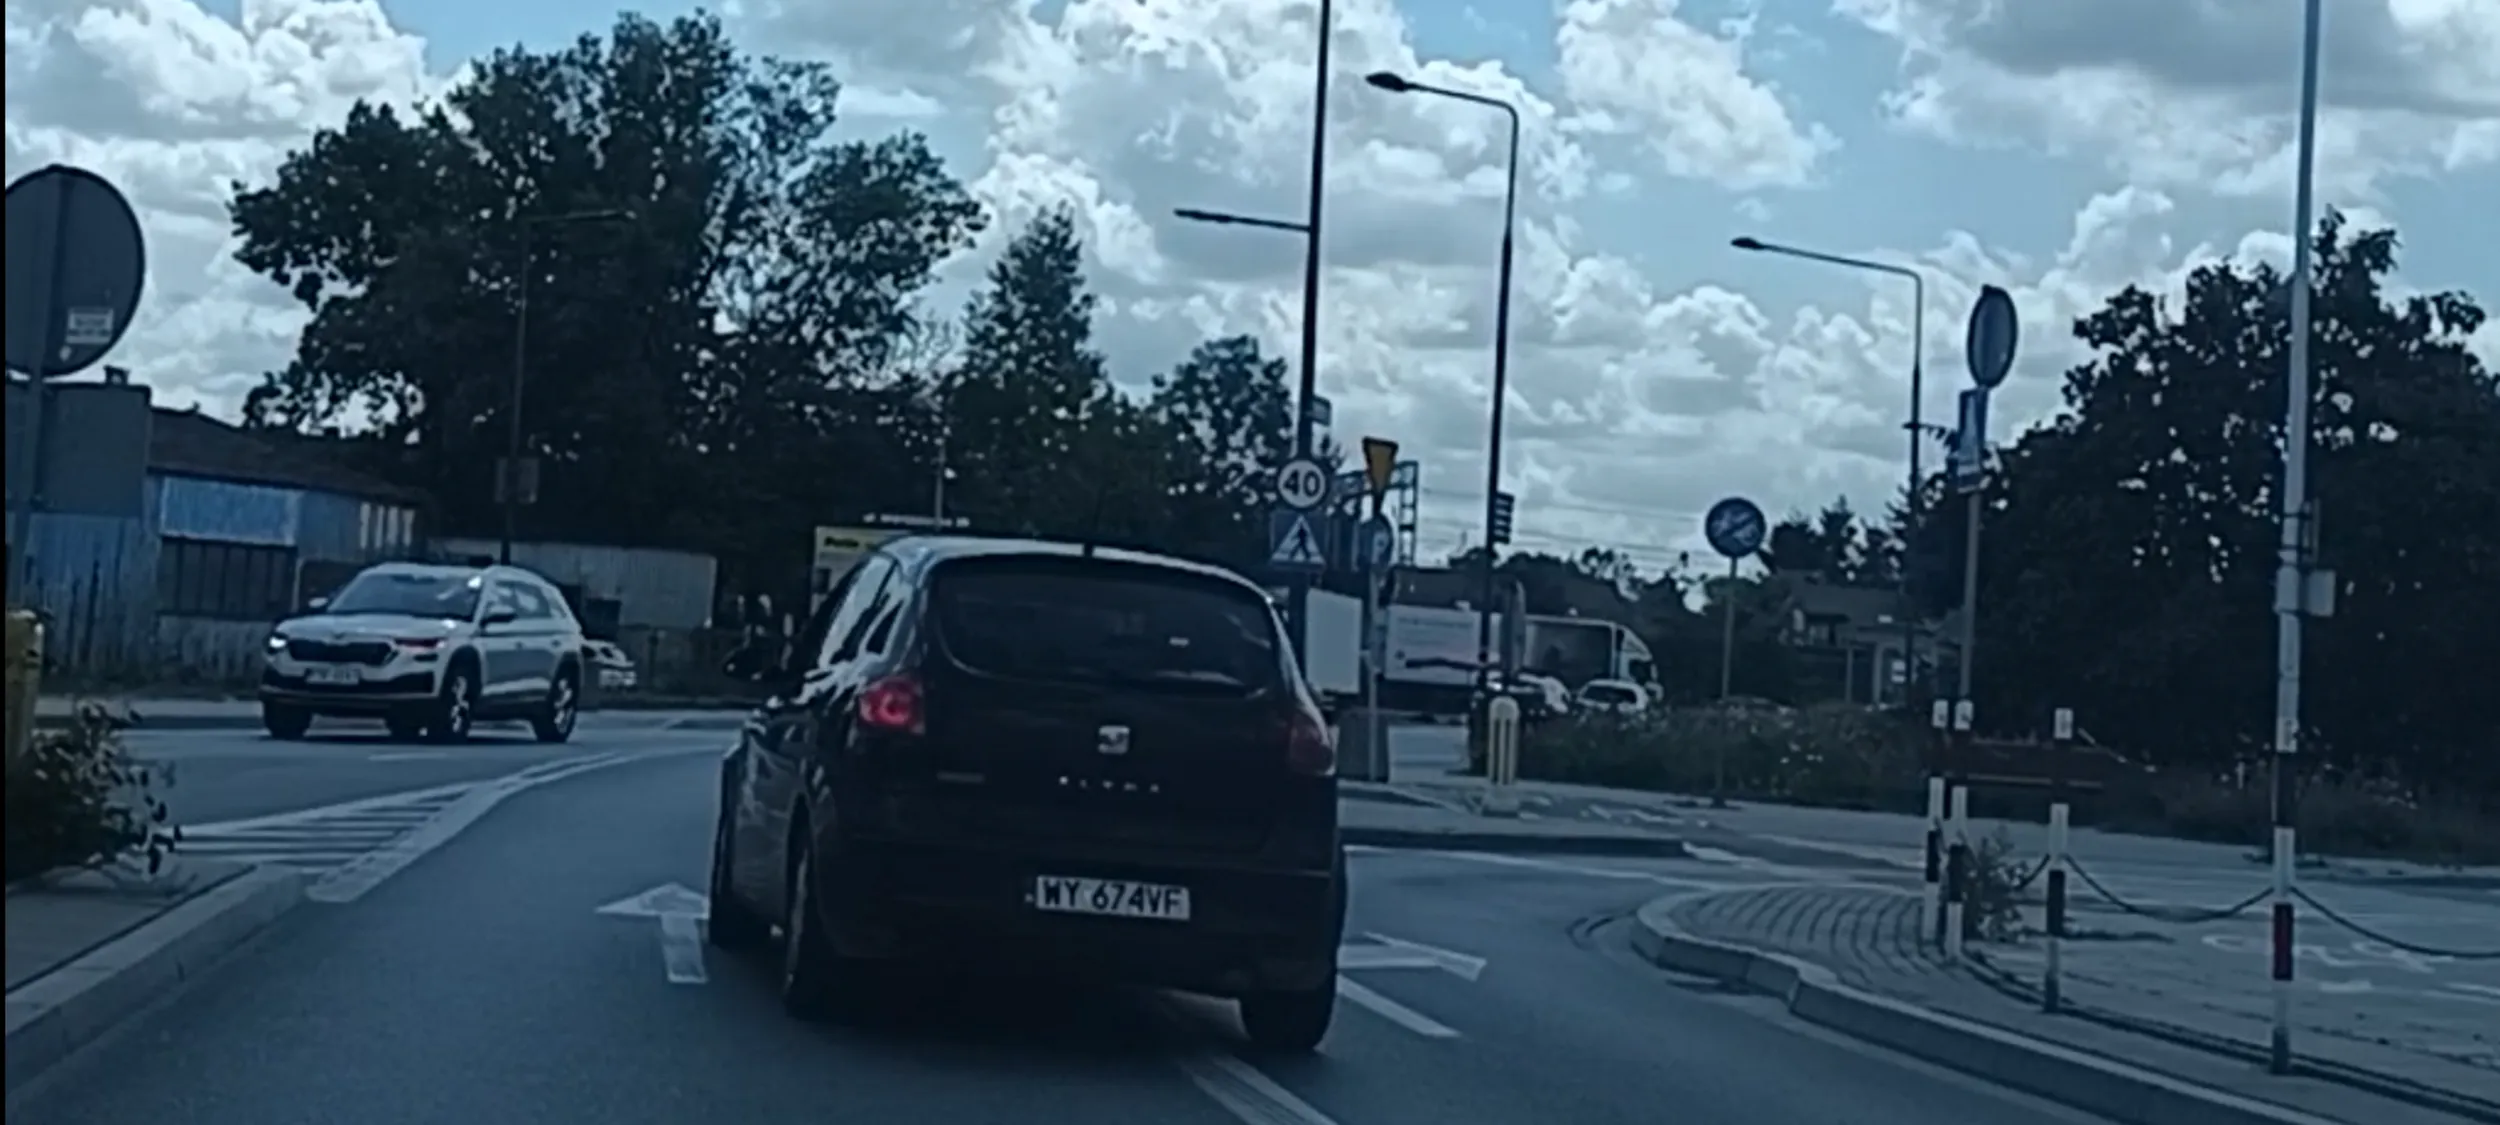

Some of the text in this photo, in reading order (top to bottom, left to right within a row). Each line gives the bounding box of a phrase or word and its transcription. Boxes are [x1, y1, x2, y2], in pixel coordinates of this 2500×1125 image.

[1283, 469, 1320, 497] 40
[1042, 879, 1181, 915] WY 674VF
